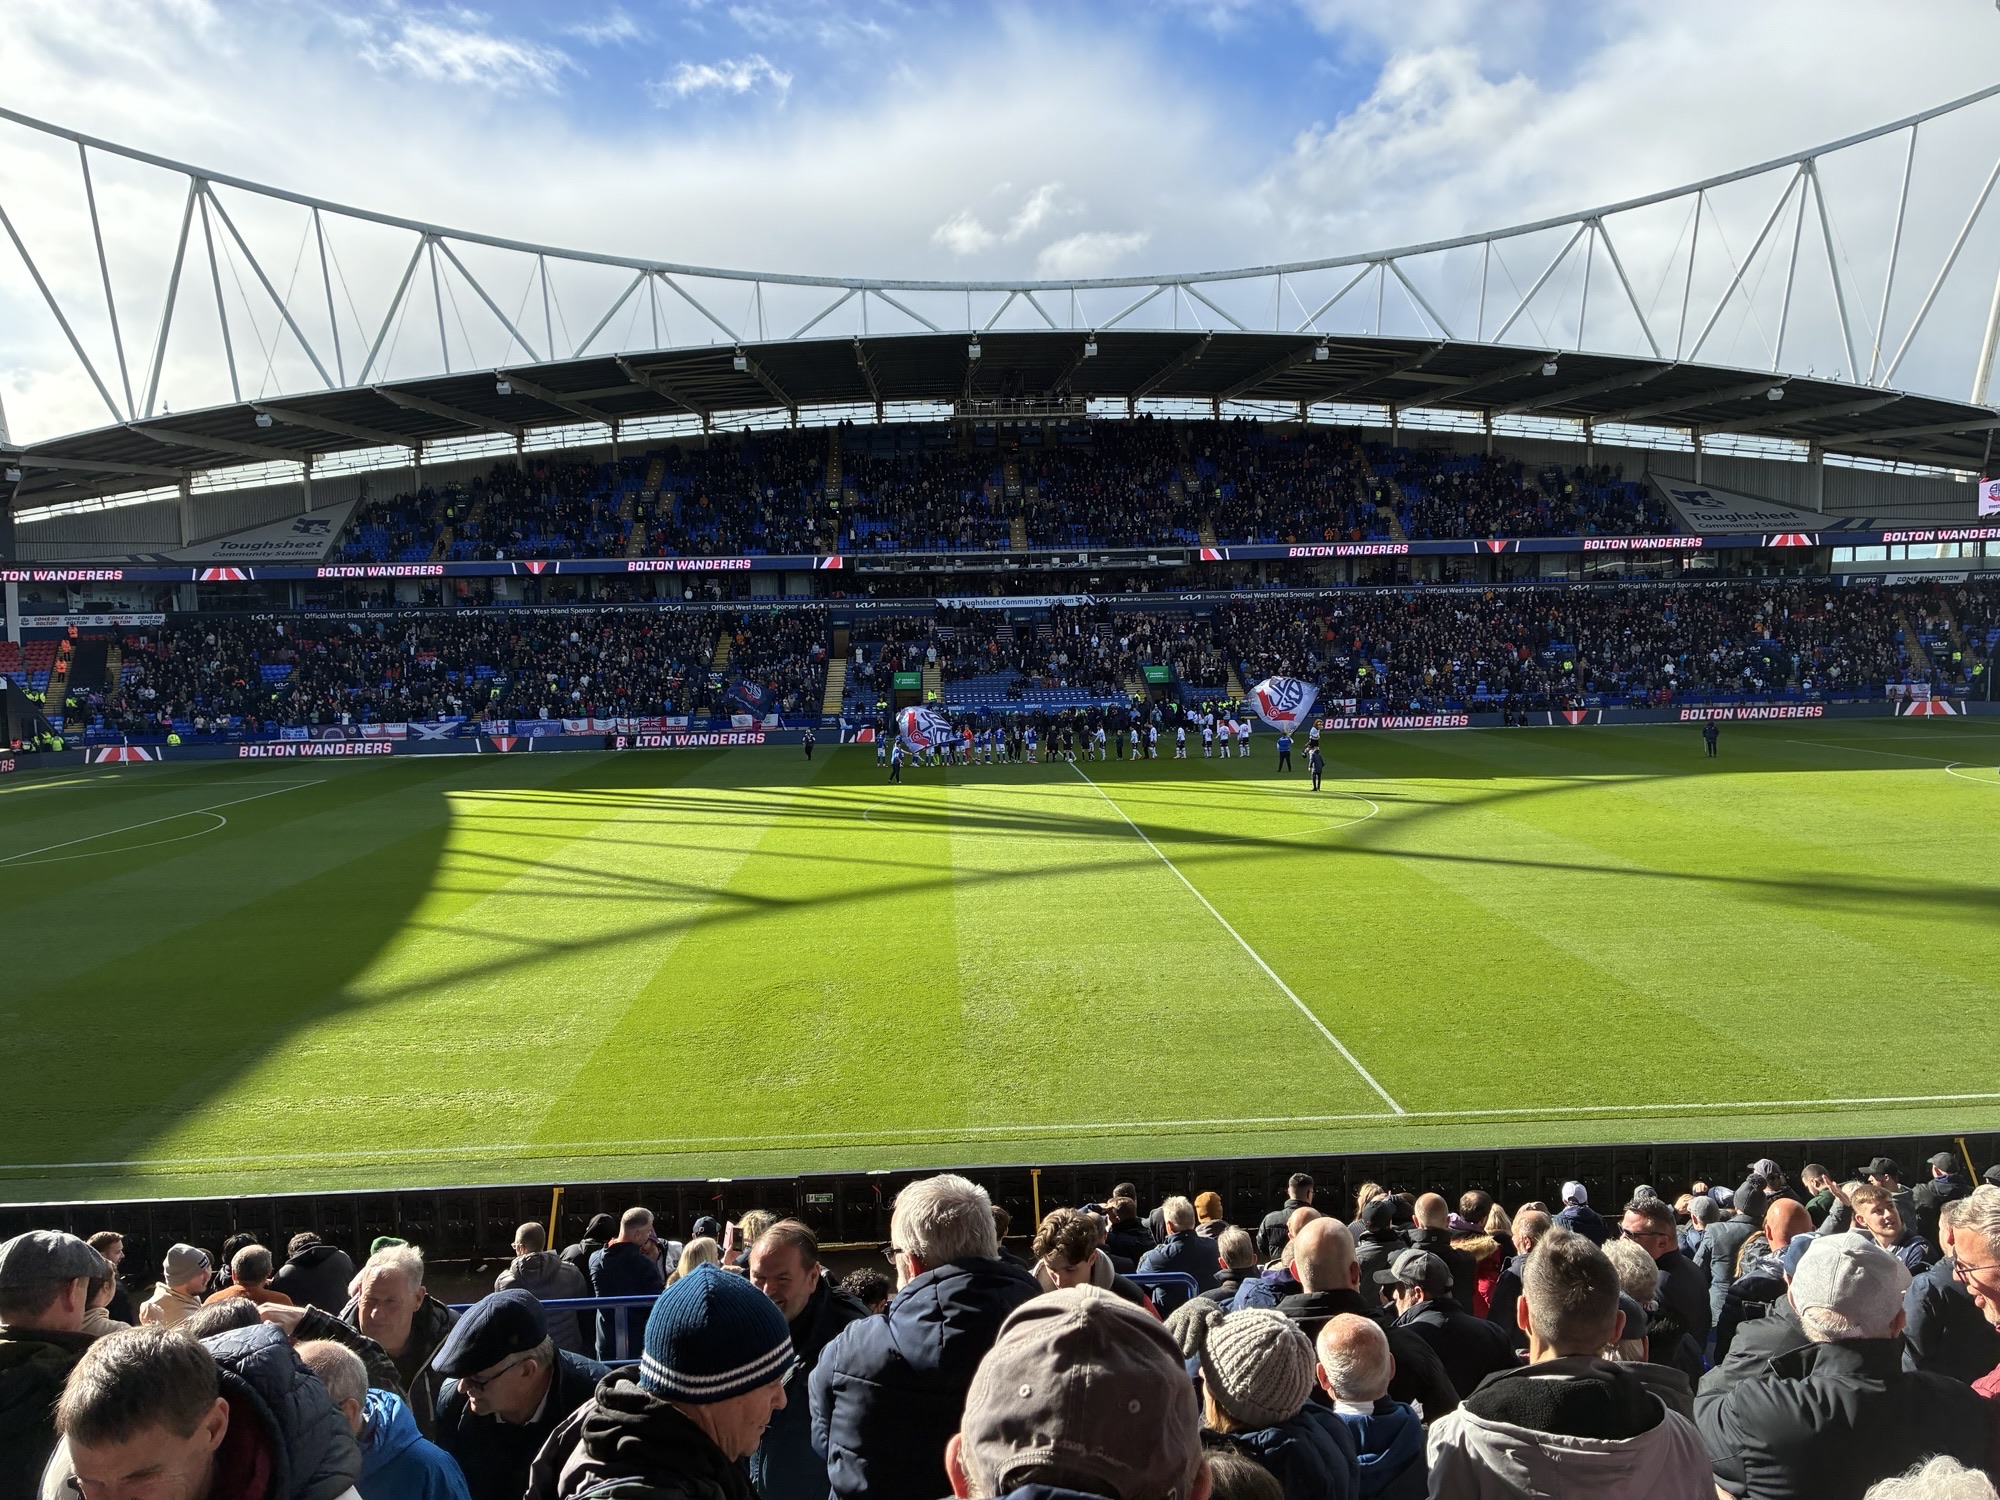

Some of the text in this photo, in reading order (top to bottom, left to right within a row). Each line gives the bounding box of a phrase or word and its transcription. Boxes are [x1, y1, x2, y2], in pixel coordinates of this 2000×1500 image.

[1689, 512, 1799, 524] Toughsheet
[1699, 522, 1760, 530] Community
[1883, 531, 1934, 542] BOLTON
[220, 540, 324, 551] Toughsheet
[1584, 538, 1703, 550] BOLTON WANDERERS
[212, 551, 273, 559] Community
[1289, 545, 1409, 557] BOLTON WANDERERS
[317, 565, 443, 577] BOLTON WANDERERS
[628, 559, 752, 571] BOLTON WANDERERS
[0, 570, 123, 581] TON WANDERERS
[958, 599, 999, 607] Toughsheet
[1001, 598, 1042, 607] Community
[348, 611, 366, 619] Stand
[367, 611, 393, 619] Sponsor
[1680, 706, 1824, 720] BOLTON WANDERERS
[1325, 715, 1469, 729] BOLTON WANDERERS
[616, 733, 766, 748] BLTON WANDERERS
[239, 742, 392, 757] BOLTON WANDERERS
